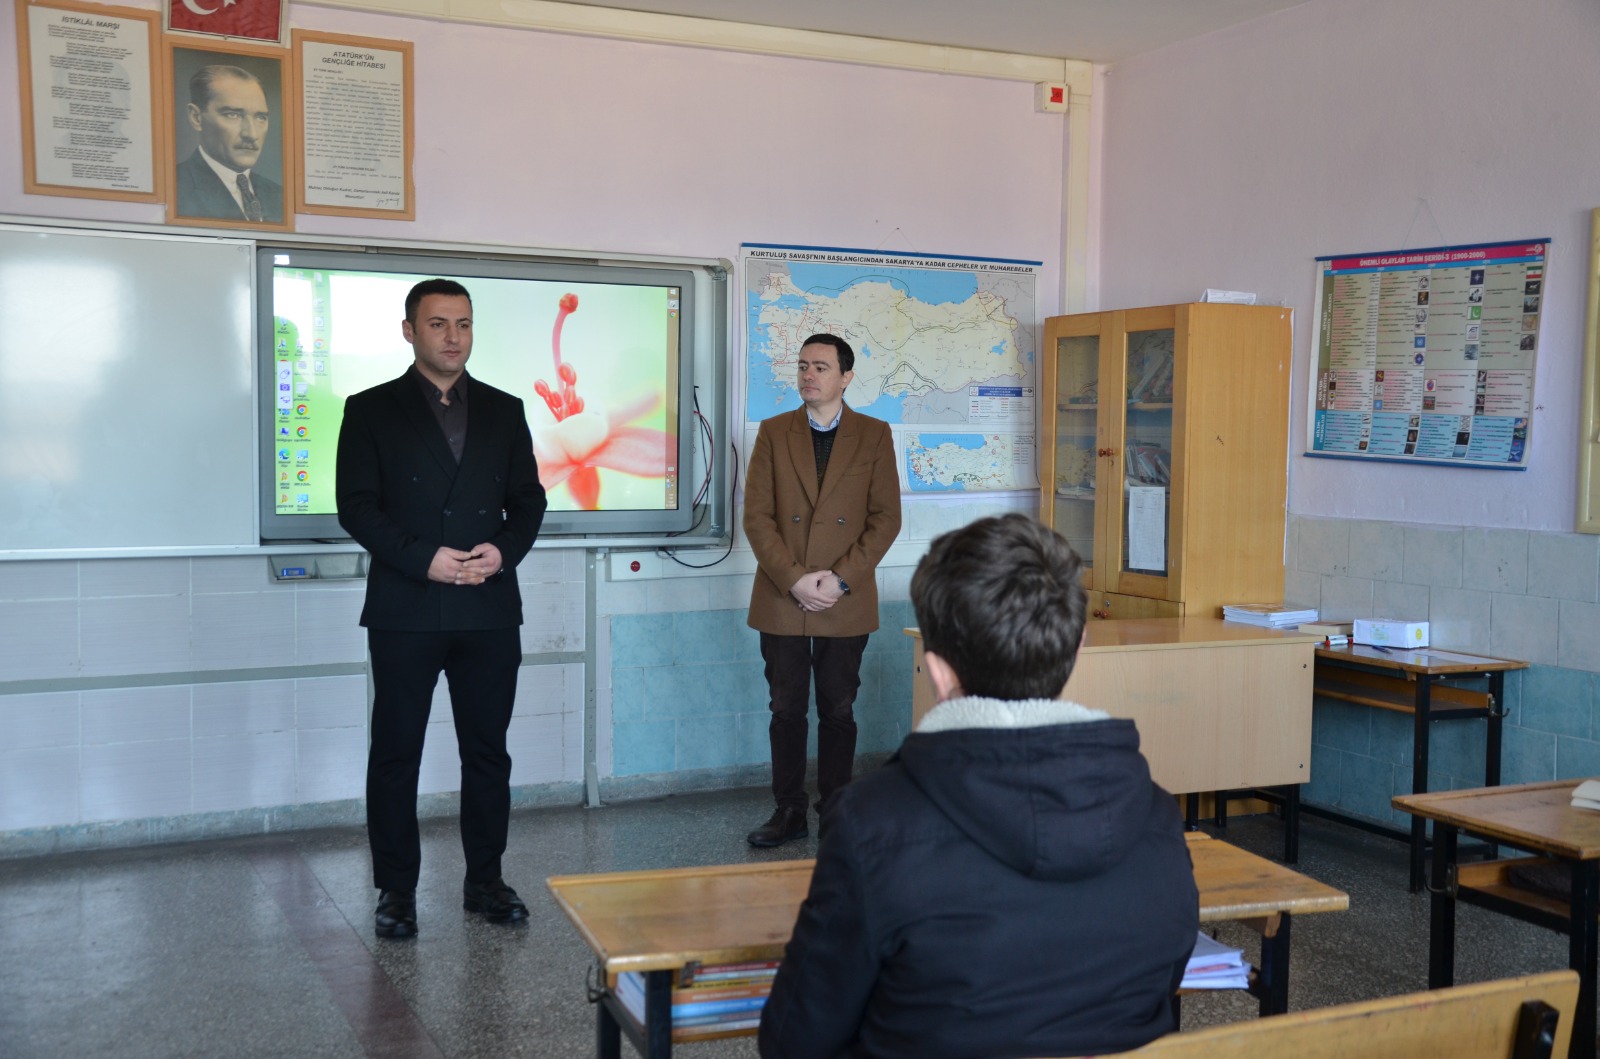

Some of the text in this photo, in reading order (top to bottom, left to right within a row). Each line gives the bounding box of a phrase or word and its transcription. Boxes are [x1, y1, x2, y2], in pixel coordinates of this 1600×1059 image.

[62, 15, 120, 30] İSTİKLÂL MARŞI
[322, 57, 386, 69] GENÇLİĞE HİTABESİ
[750, 250, 787, 259] KURTULUŞ
[789, 252, 826, 261] SAVAŞI'NIN
[827, 254, 884, 264] BAŞLANGICINDAN
[885, 258, 924, 267] SAKARYA'YA
[947, 262, 978, 270] CEPHELER
[989, 265, 1033, 273] MUHAREBELER
[1359, 257, 1380, 266] ÖNEMLİ
[1381, 256, 1406, 265] OLAYLAR
